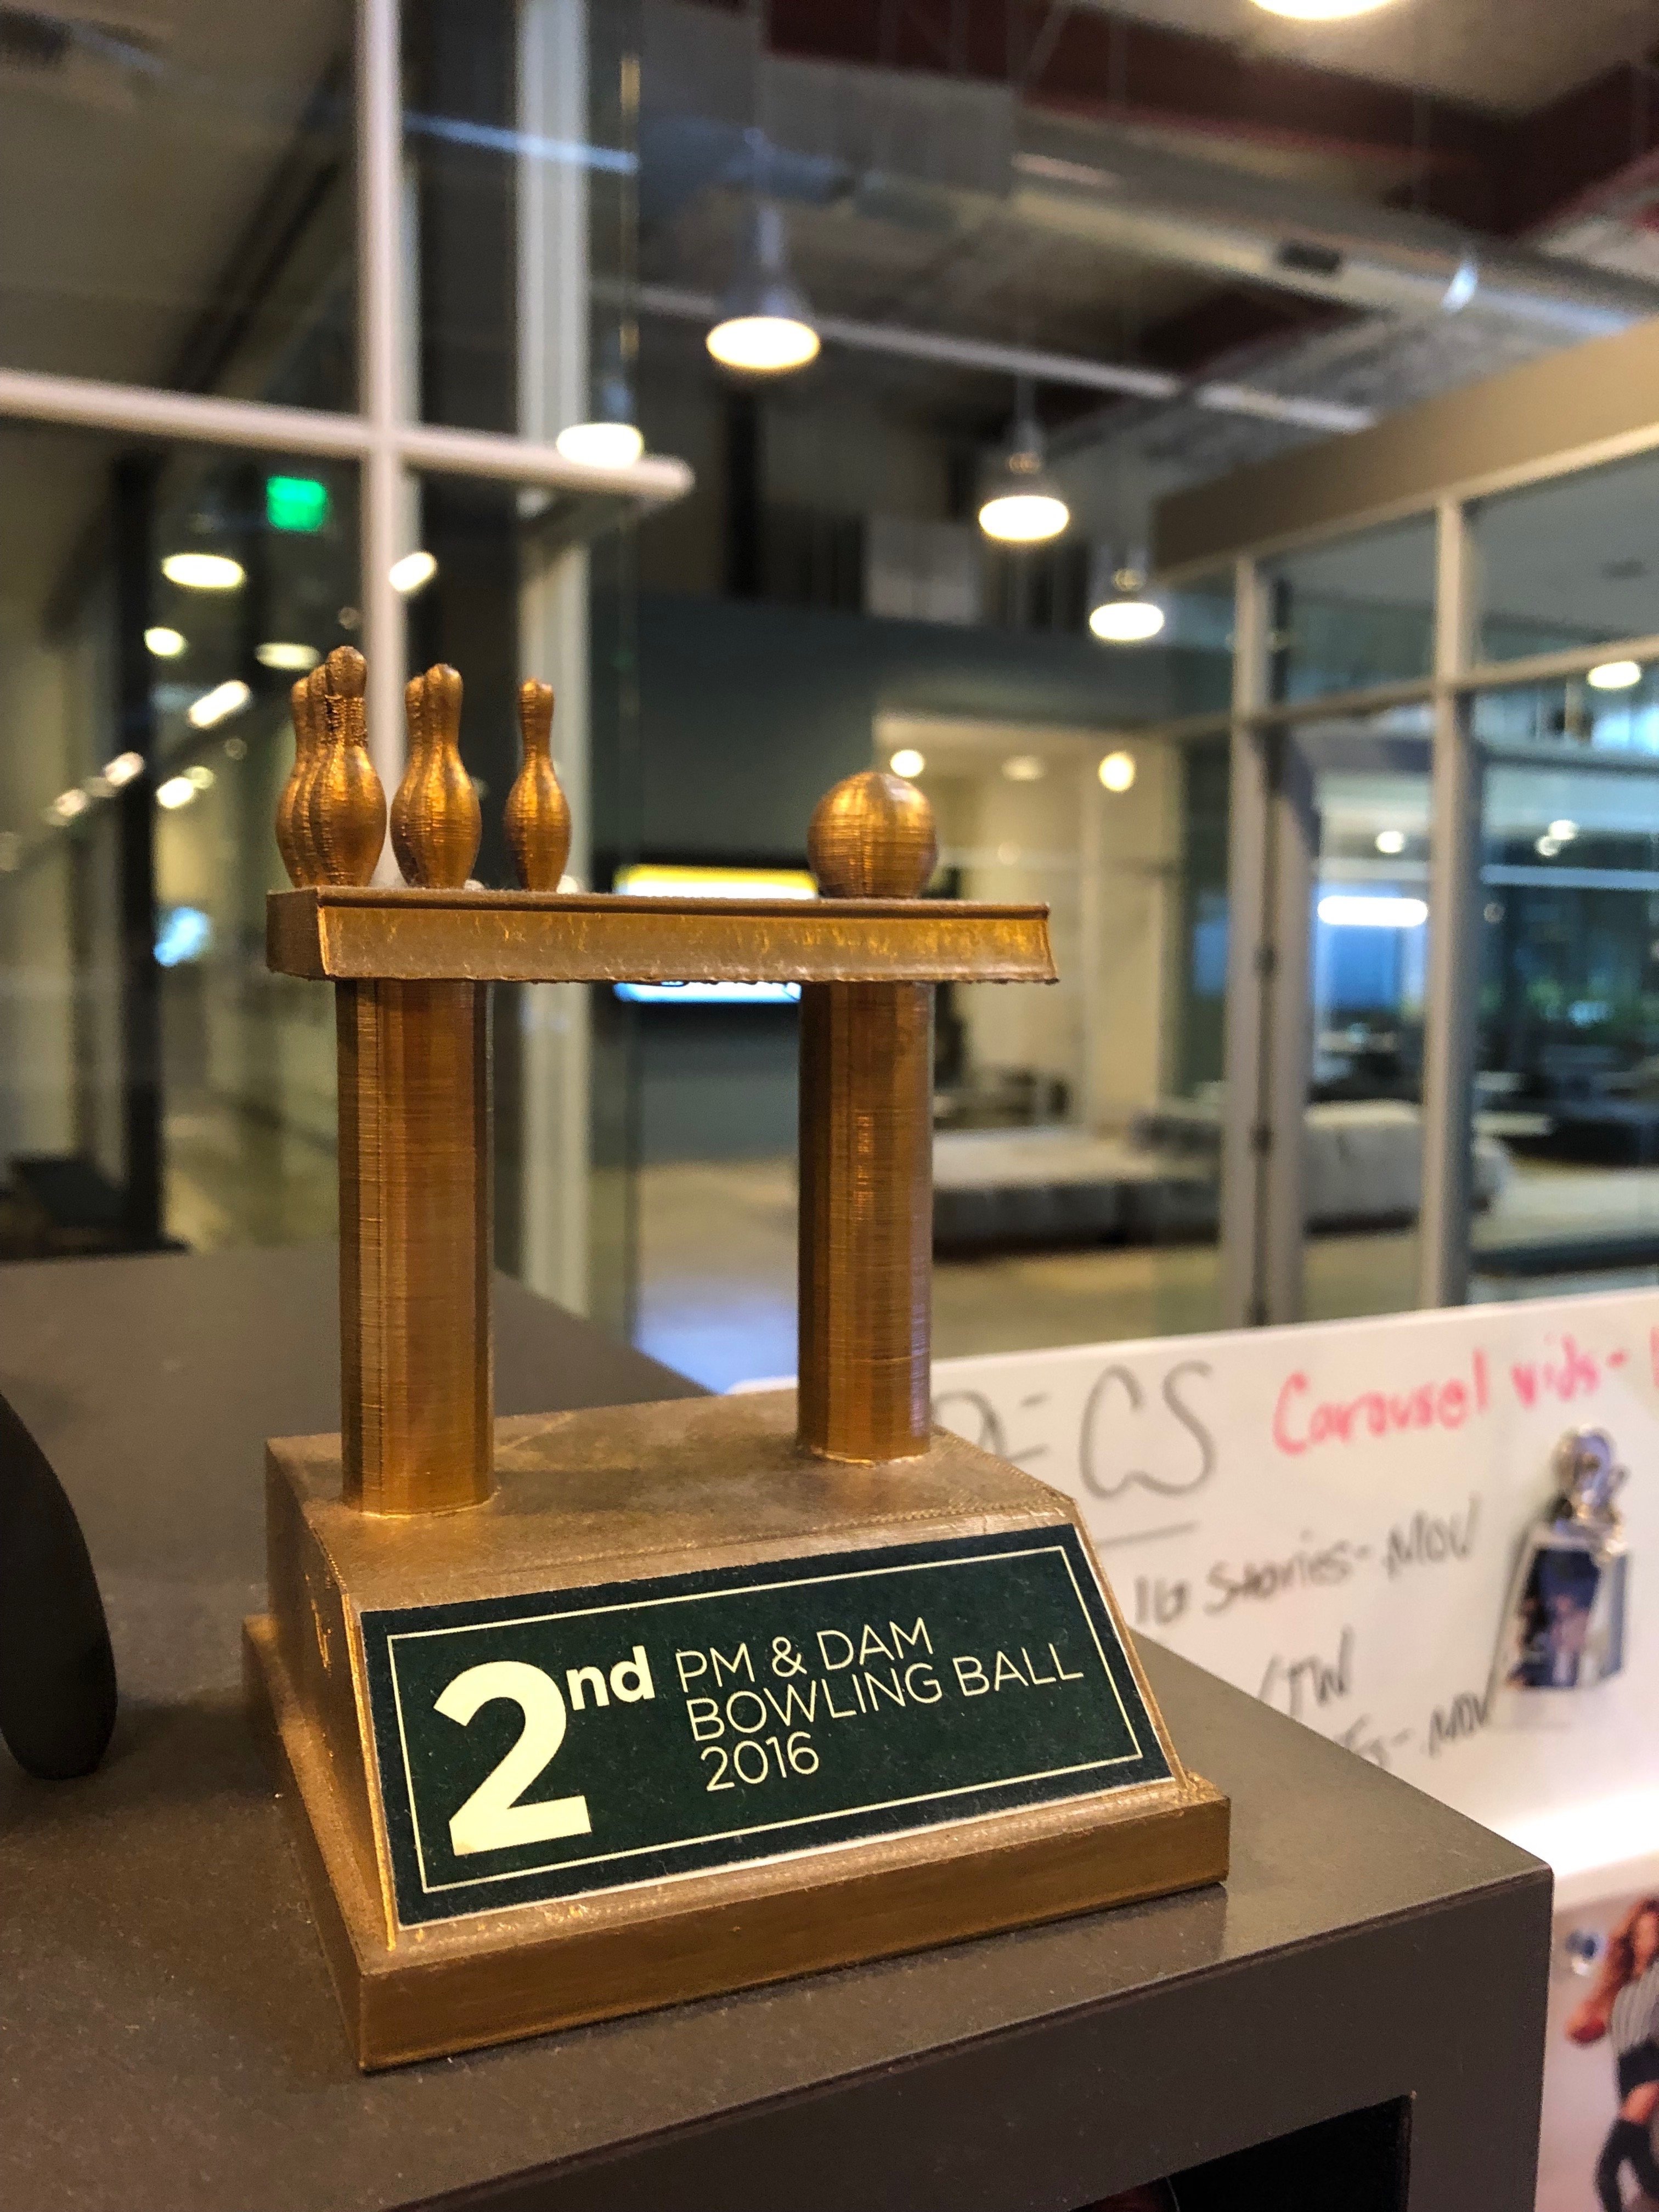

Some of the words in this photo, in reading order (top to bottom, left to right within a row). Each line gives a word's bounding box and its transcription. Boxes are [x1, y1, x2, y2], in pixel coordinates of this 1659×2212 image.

[1273, 1346, 1490, 1456] Carousel
[676, 1643, 755, 1693] PM
[772, 1637, 808, 1678] &
[816, 1617, 934, 1671] DAM
[686, 1662, 943, 1741] BOWLING
[952, 1643, 1084, 1697] BALL
[433, 1645, 656, 1857] 2nd
[701, 1731, 819, 1791] 2016
